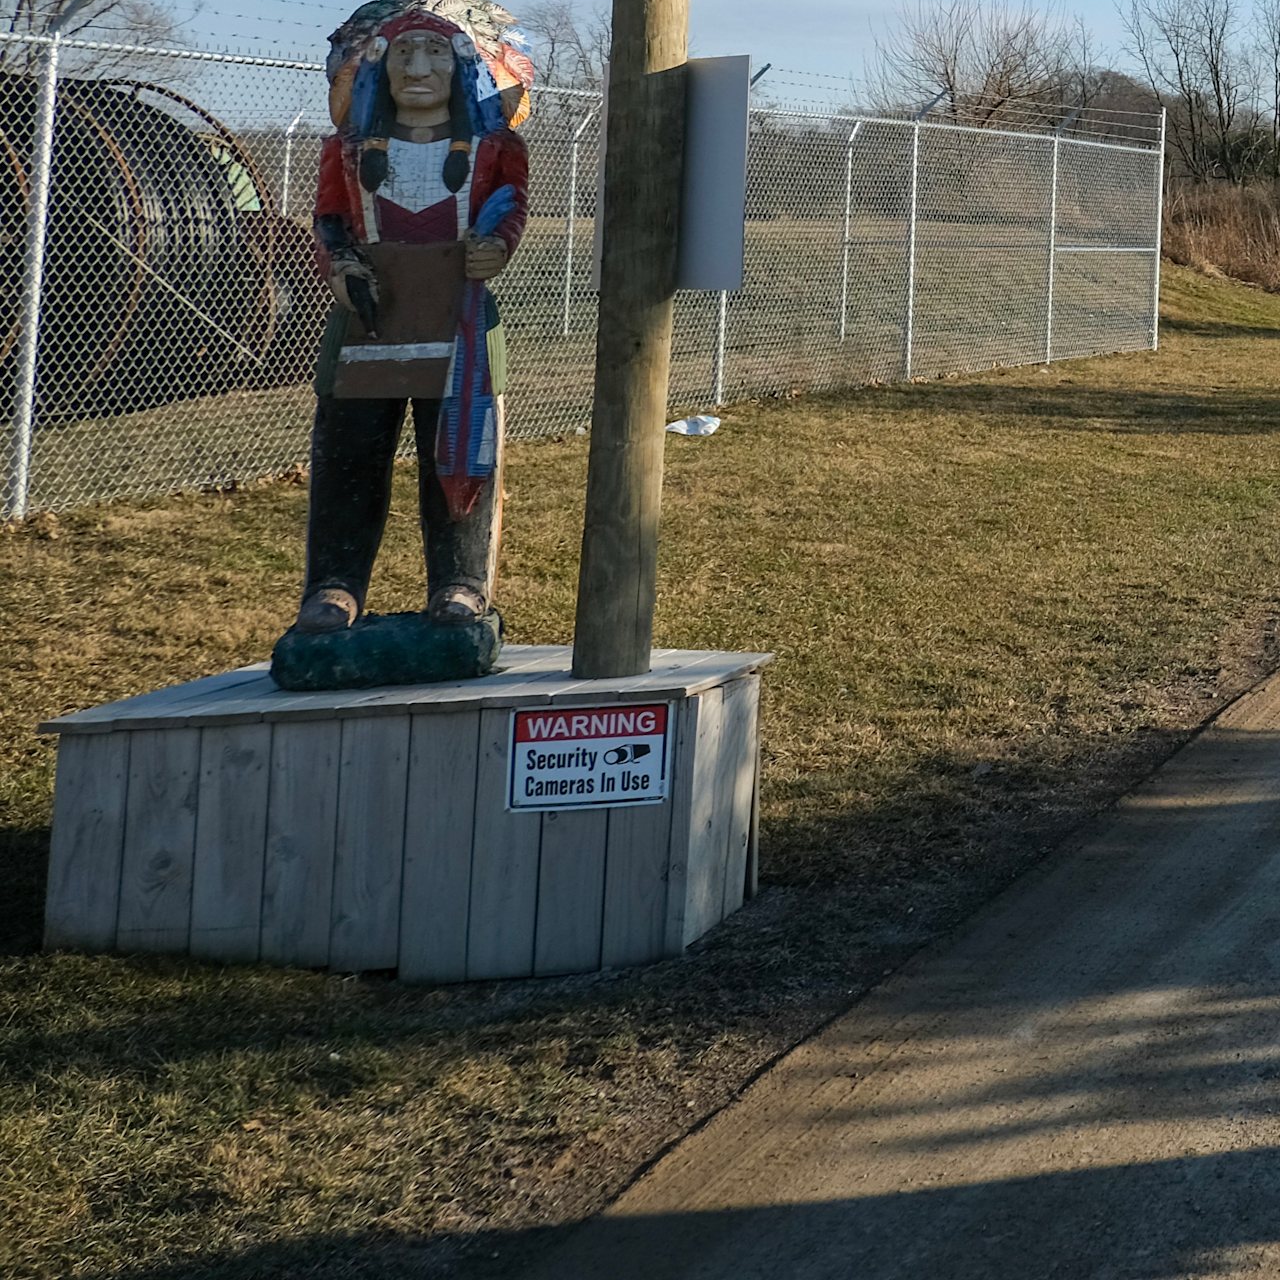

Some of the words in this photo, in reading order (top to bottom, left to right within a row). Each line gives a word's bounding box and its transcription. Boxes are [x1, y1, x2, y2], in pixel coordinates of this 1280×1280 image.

[527, 711, 656, 739] WARNING
[526, 747, 598, 771] Security
[525, 776, 594, 797] Cameras
[600, 772, 615, 793] In
[621, 770, 650, 791] Use
